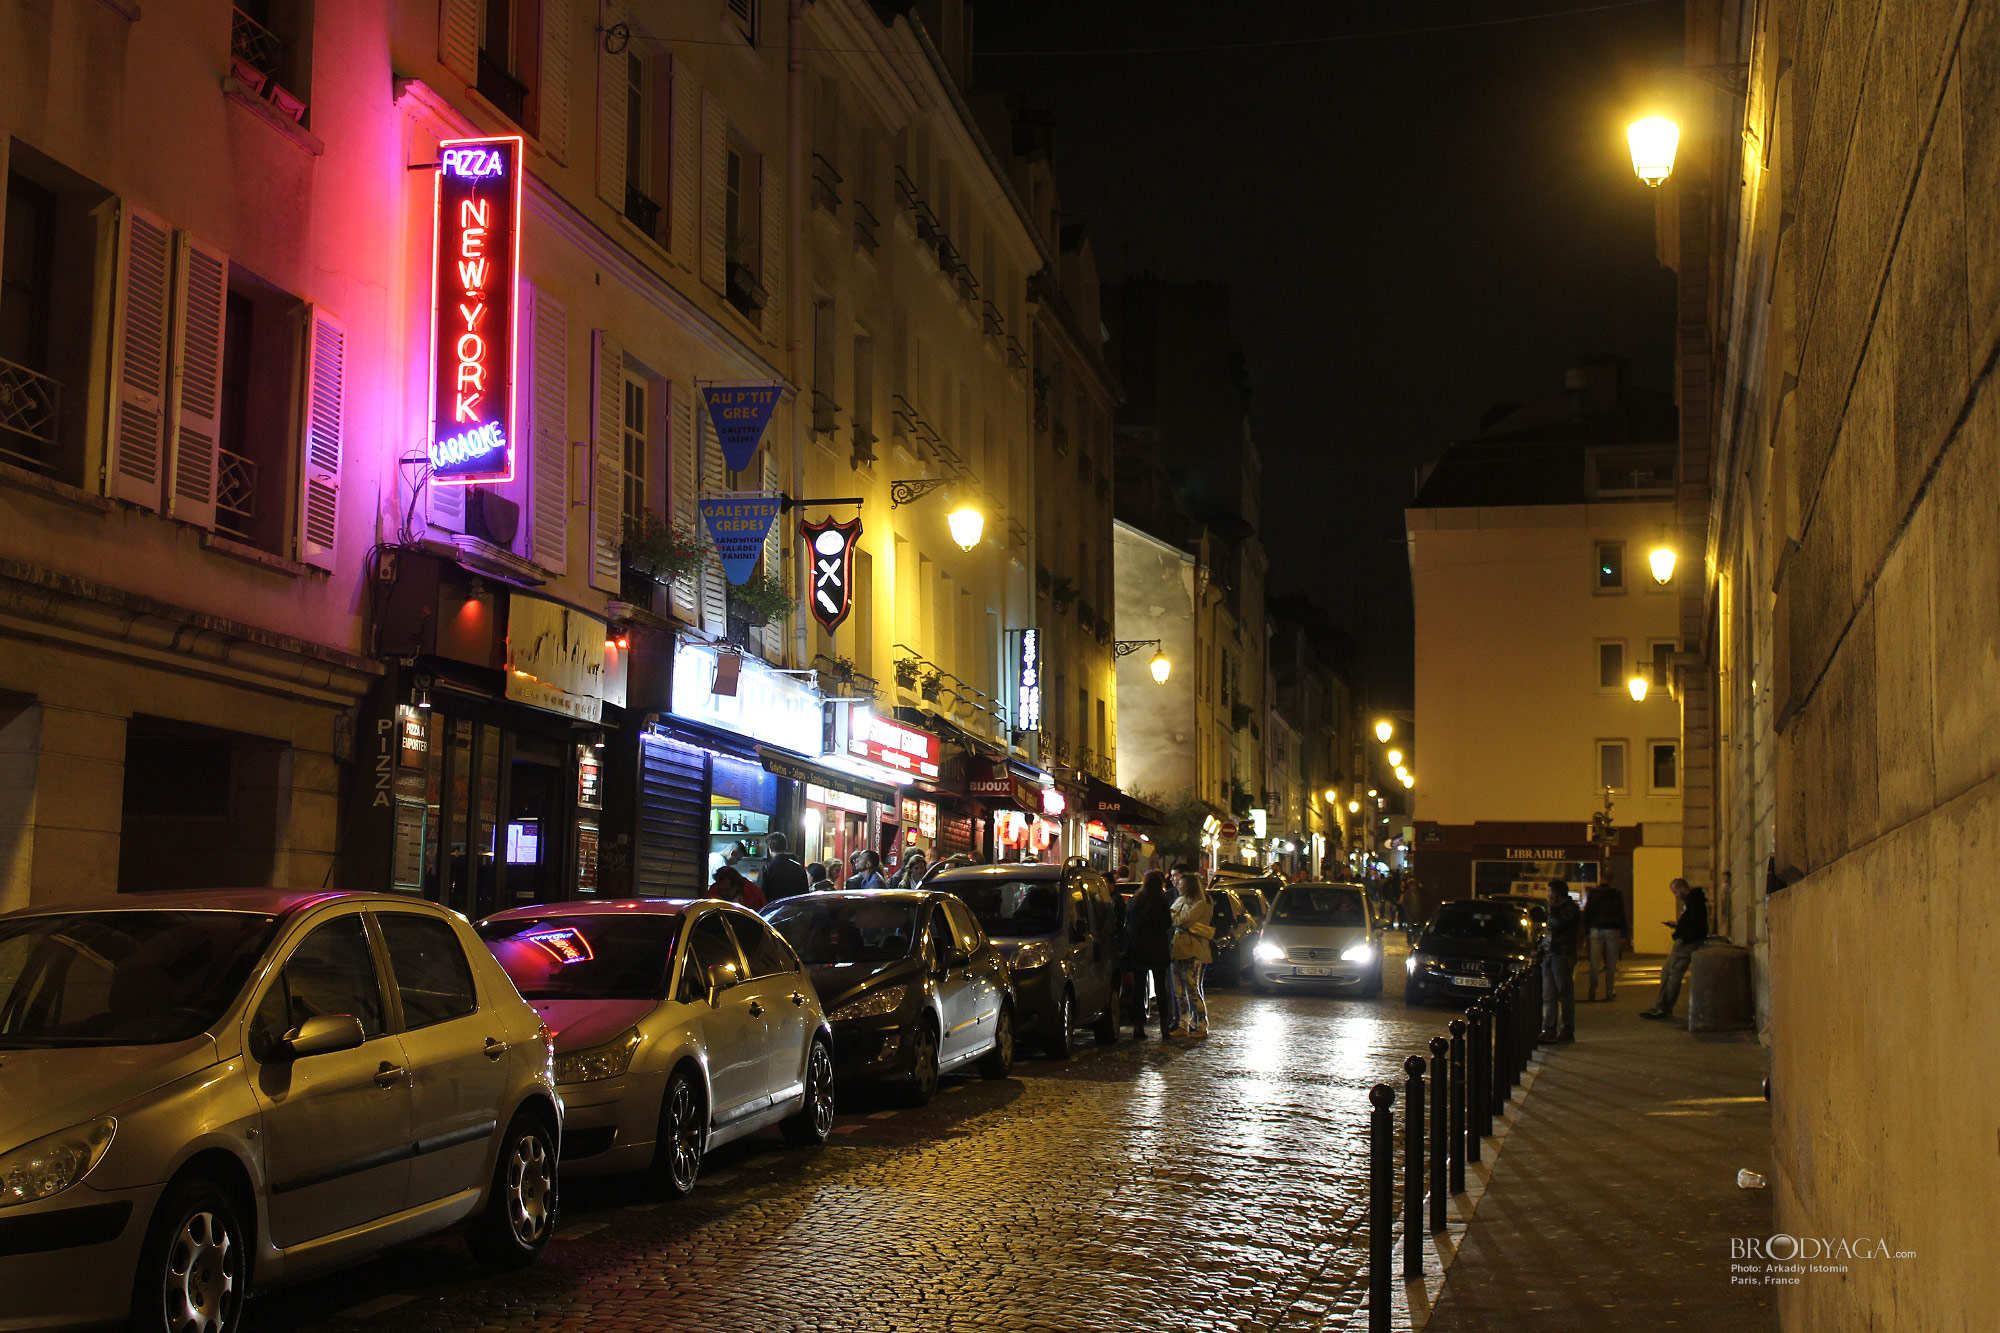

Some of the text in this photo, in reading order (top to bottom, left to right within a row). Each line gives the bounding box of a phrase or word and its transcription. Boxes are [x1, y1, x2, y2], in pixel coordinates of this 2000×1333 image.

[441, 149, 503, 177] PIZZA
[710, 391, 773, 405] AU P'TIT
[722, 406, 759, 419] GREC
[722, 426, 760, 435] GALETTES
[427, 420, 506, 470] KARAOKE
[703, 505, 776, 517] GALETTES
[715, 517, 764, 531] CRÊPES
[405, 722, 421, 737] PIZZA
[402, 737, 428, 753] EMPORTER
[373, 719, 393, 807] PIZZA
[970, 781, 1011, 792] BIJOUX
[1506, 848, 1566, 859] LIBRAIRIE
